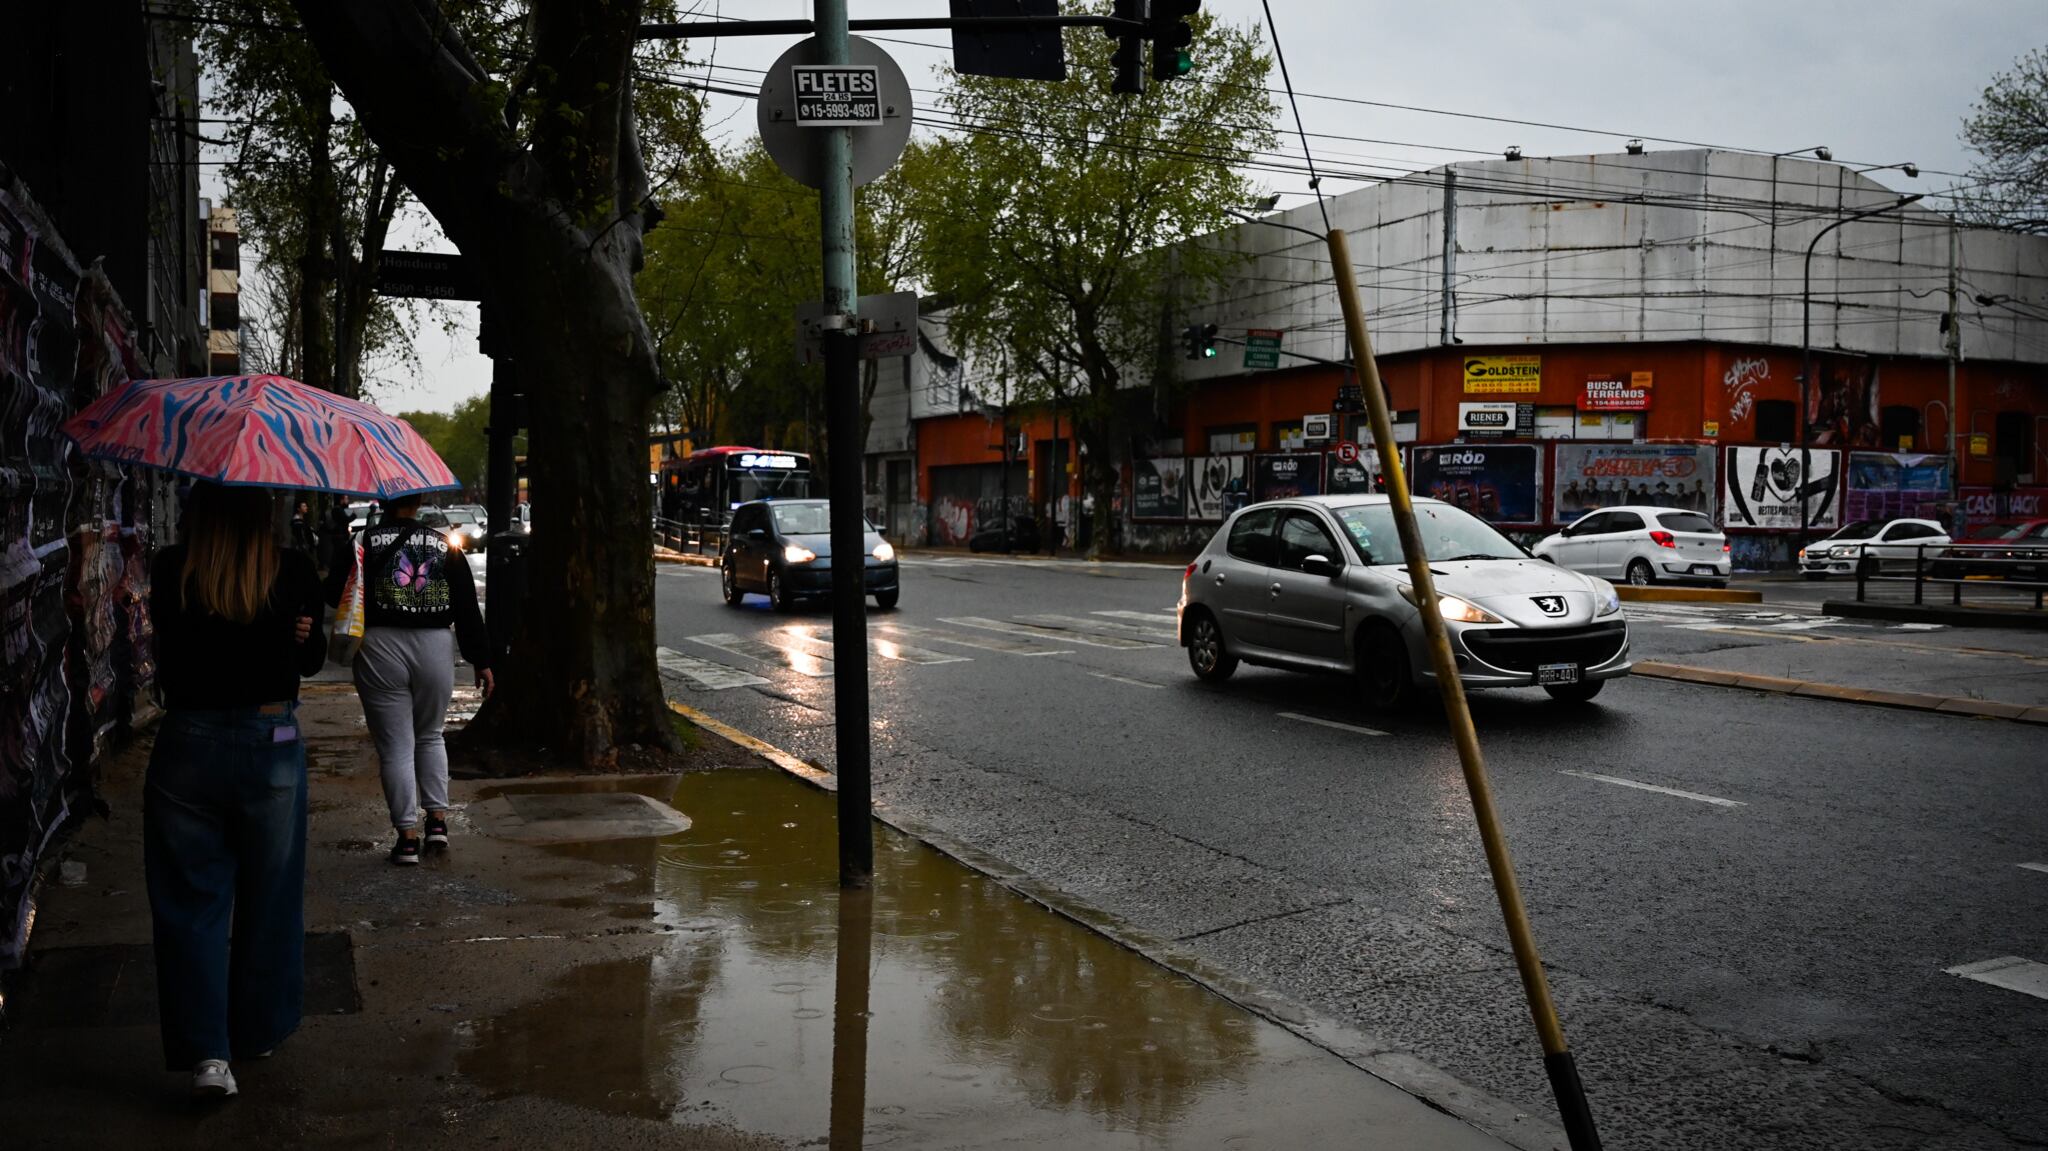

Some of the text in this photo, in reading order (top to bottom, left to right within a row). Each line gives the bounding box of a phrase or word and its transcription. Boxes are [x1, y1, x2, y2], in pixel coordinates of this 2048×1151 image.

[797, 72, 875, 92] FLETES
[825, 93, 850, 101] 24 HS
[384, 256, 448, 270] Honduras
[1465, 359, 1540, 376] GOLDSTEIN
[1586, 381, 1623, 390] BUSCA
[1587, 389, 1645, 398] TERRENOS
[1469, 413, 1503, 422] RIENER
[425, 535, 449, 554] BIG
